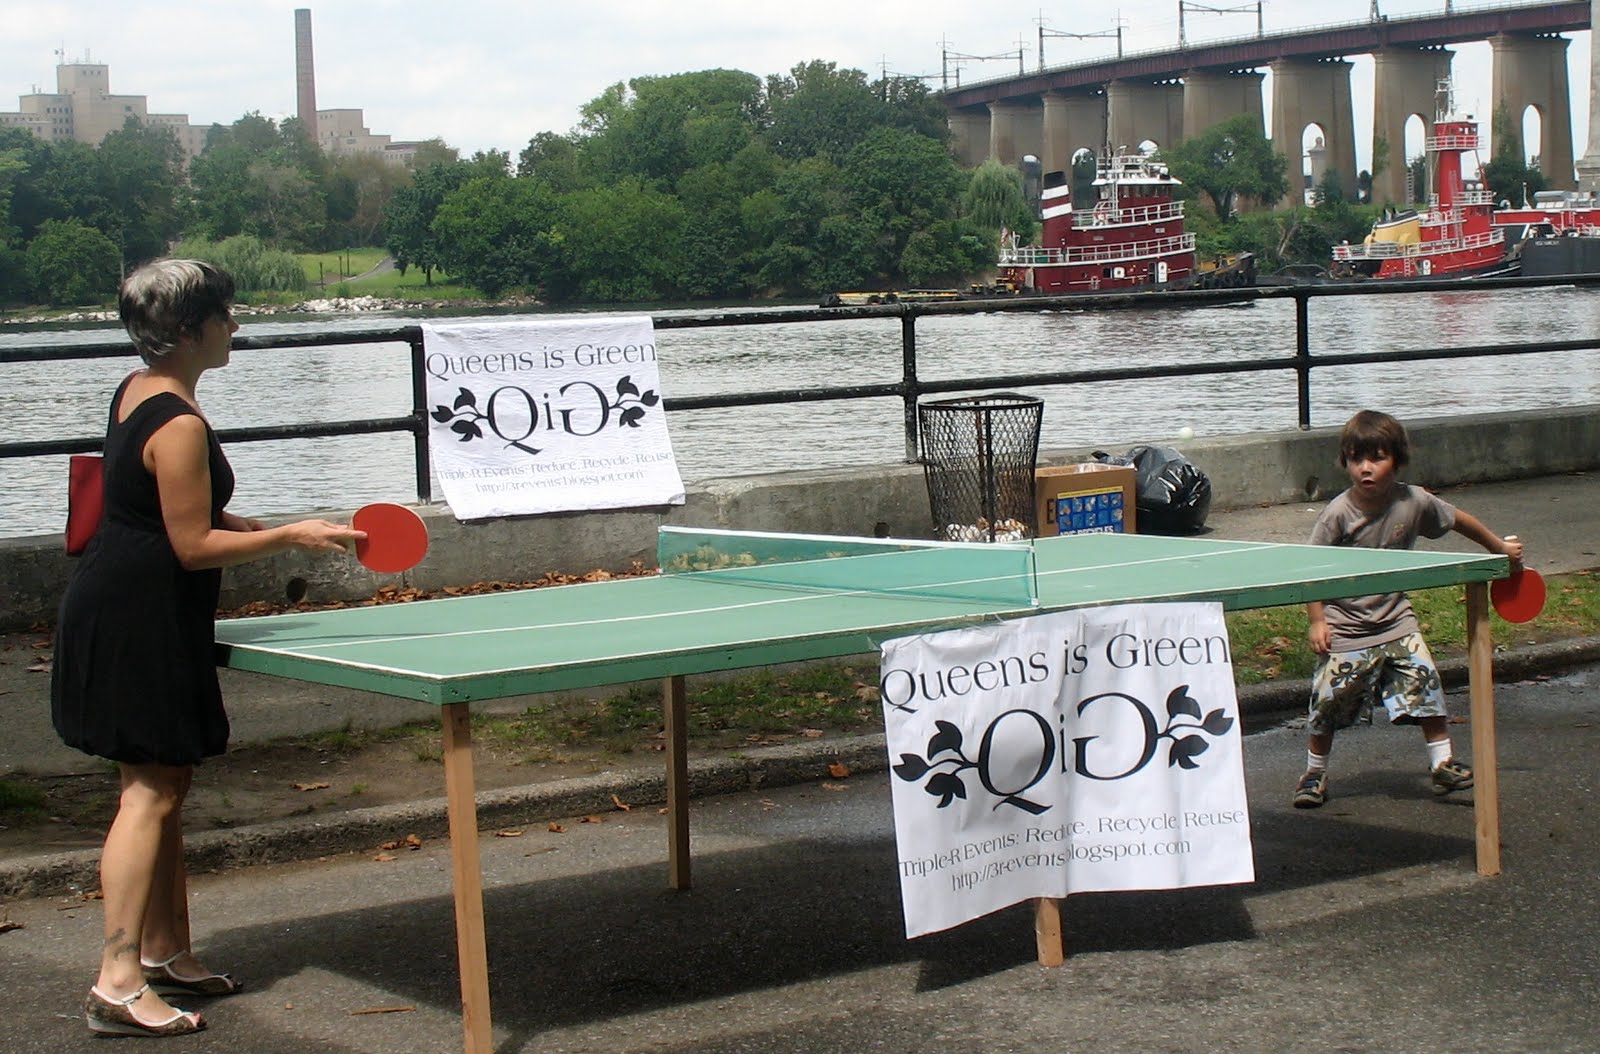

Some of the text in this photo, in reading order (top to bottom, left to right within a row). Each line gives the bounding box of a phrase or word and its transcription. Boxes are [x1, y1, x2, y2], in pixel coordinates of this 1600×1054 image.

[426, 343, 657, 381] Queens is Green
[635, 451, 673, 464] Reuse
[880, 633, 1229, 714] Queens is Green
[963, 833, 1019, 860] Events:
[1184, 810, 1245, 828] Reuse
